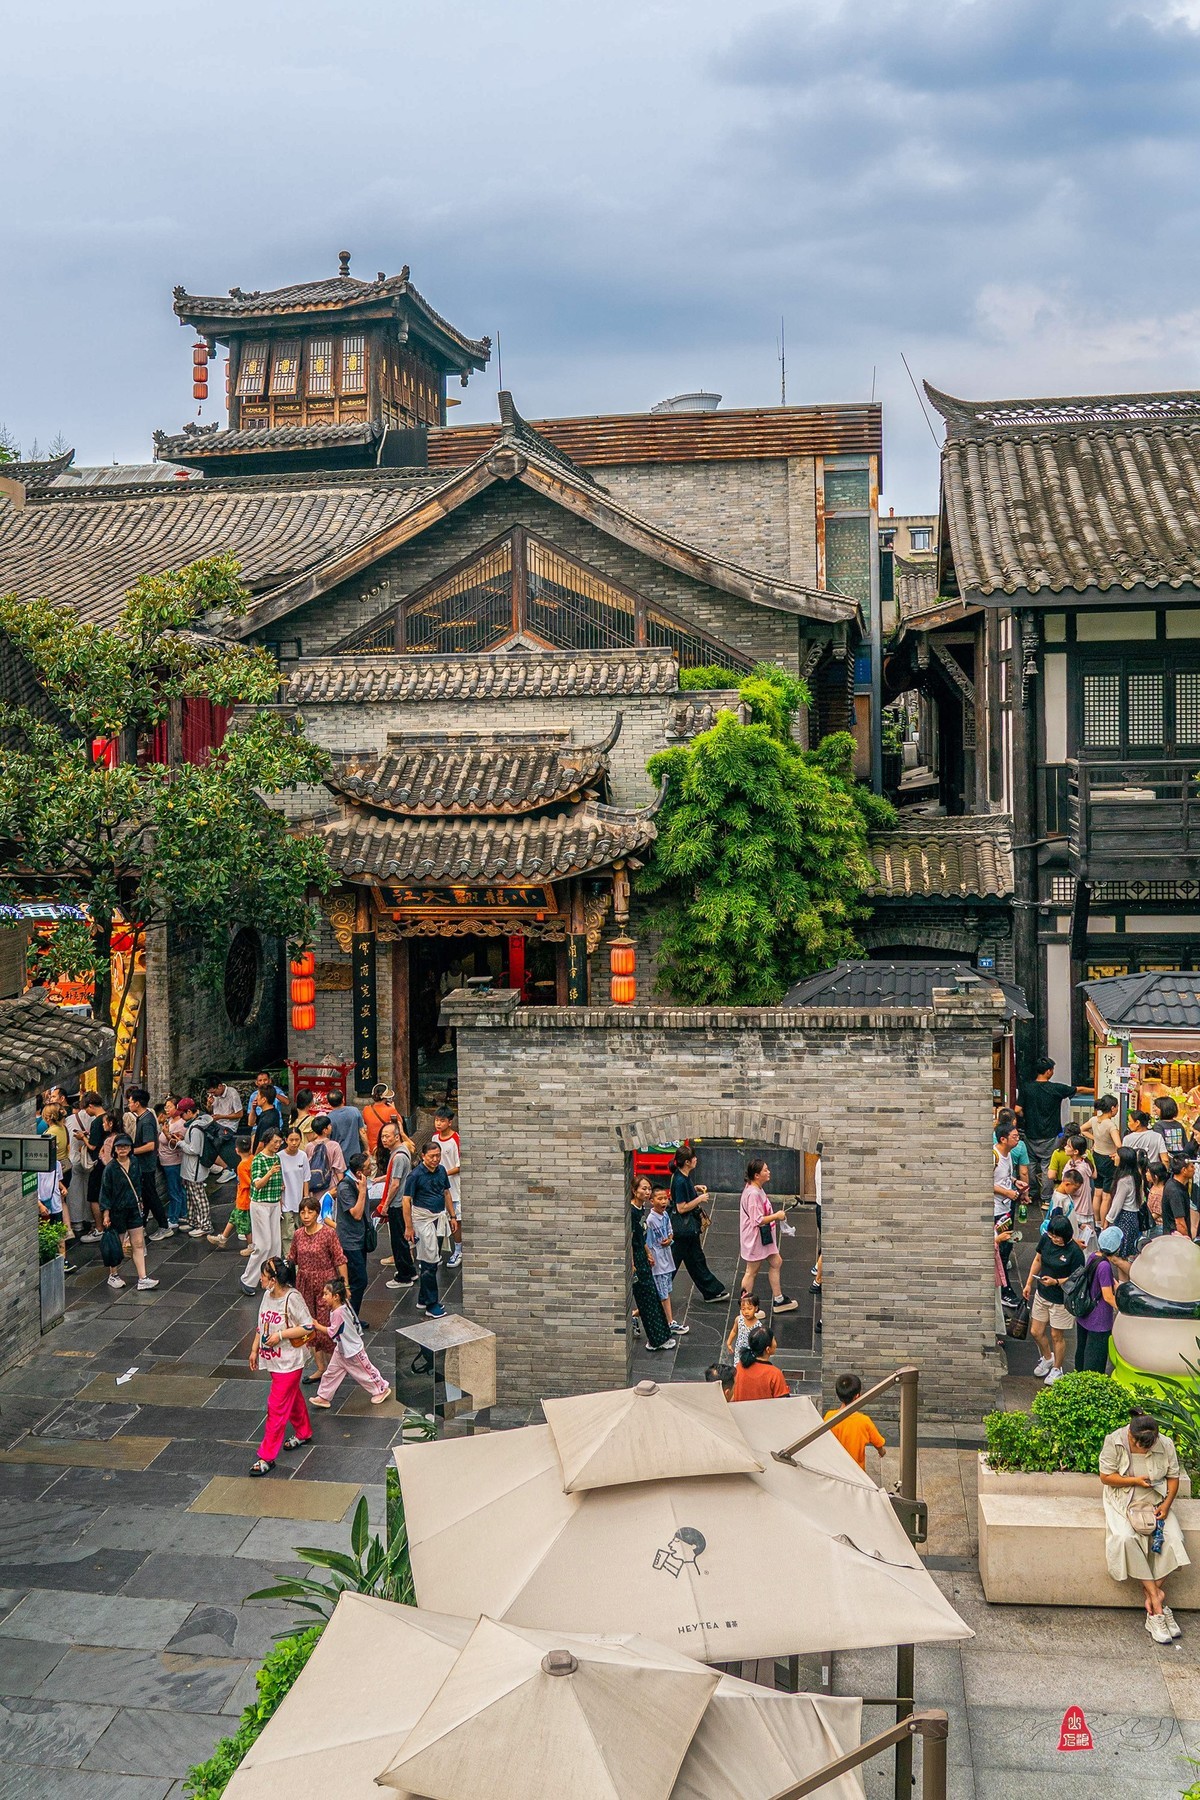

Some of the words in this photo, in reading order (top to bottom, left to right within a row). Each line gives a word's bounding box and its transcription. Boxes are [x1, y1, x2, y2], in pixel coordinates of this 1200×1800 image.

[327, 971, 340, 980] 28
[2, 1149, 13, 1165] P
[678, 1622, 719, 1634] HEYTEA
